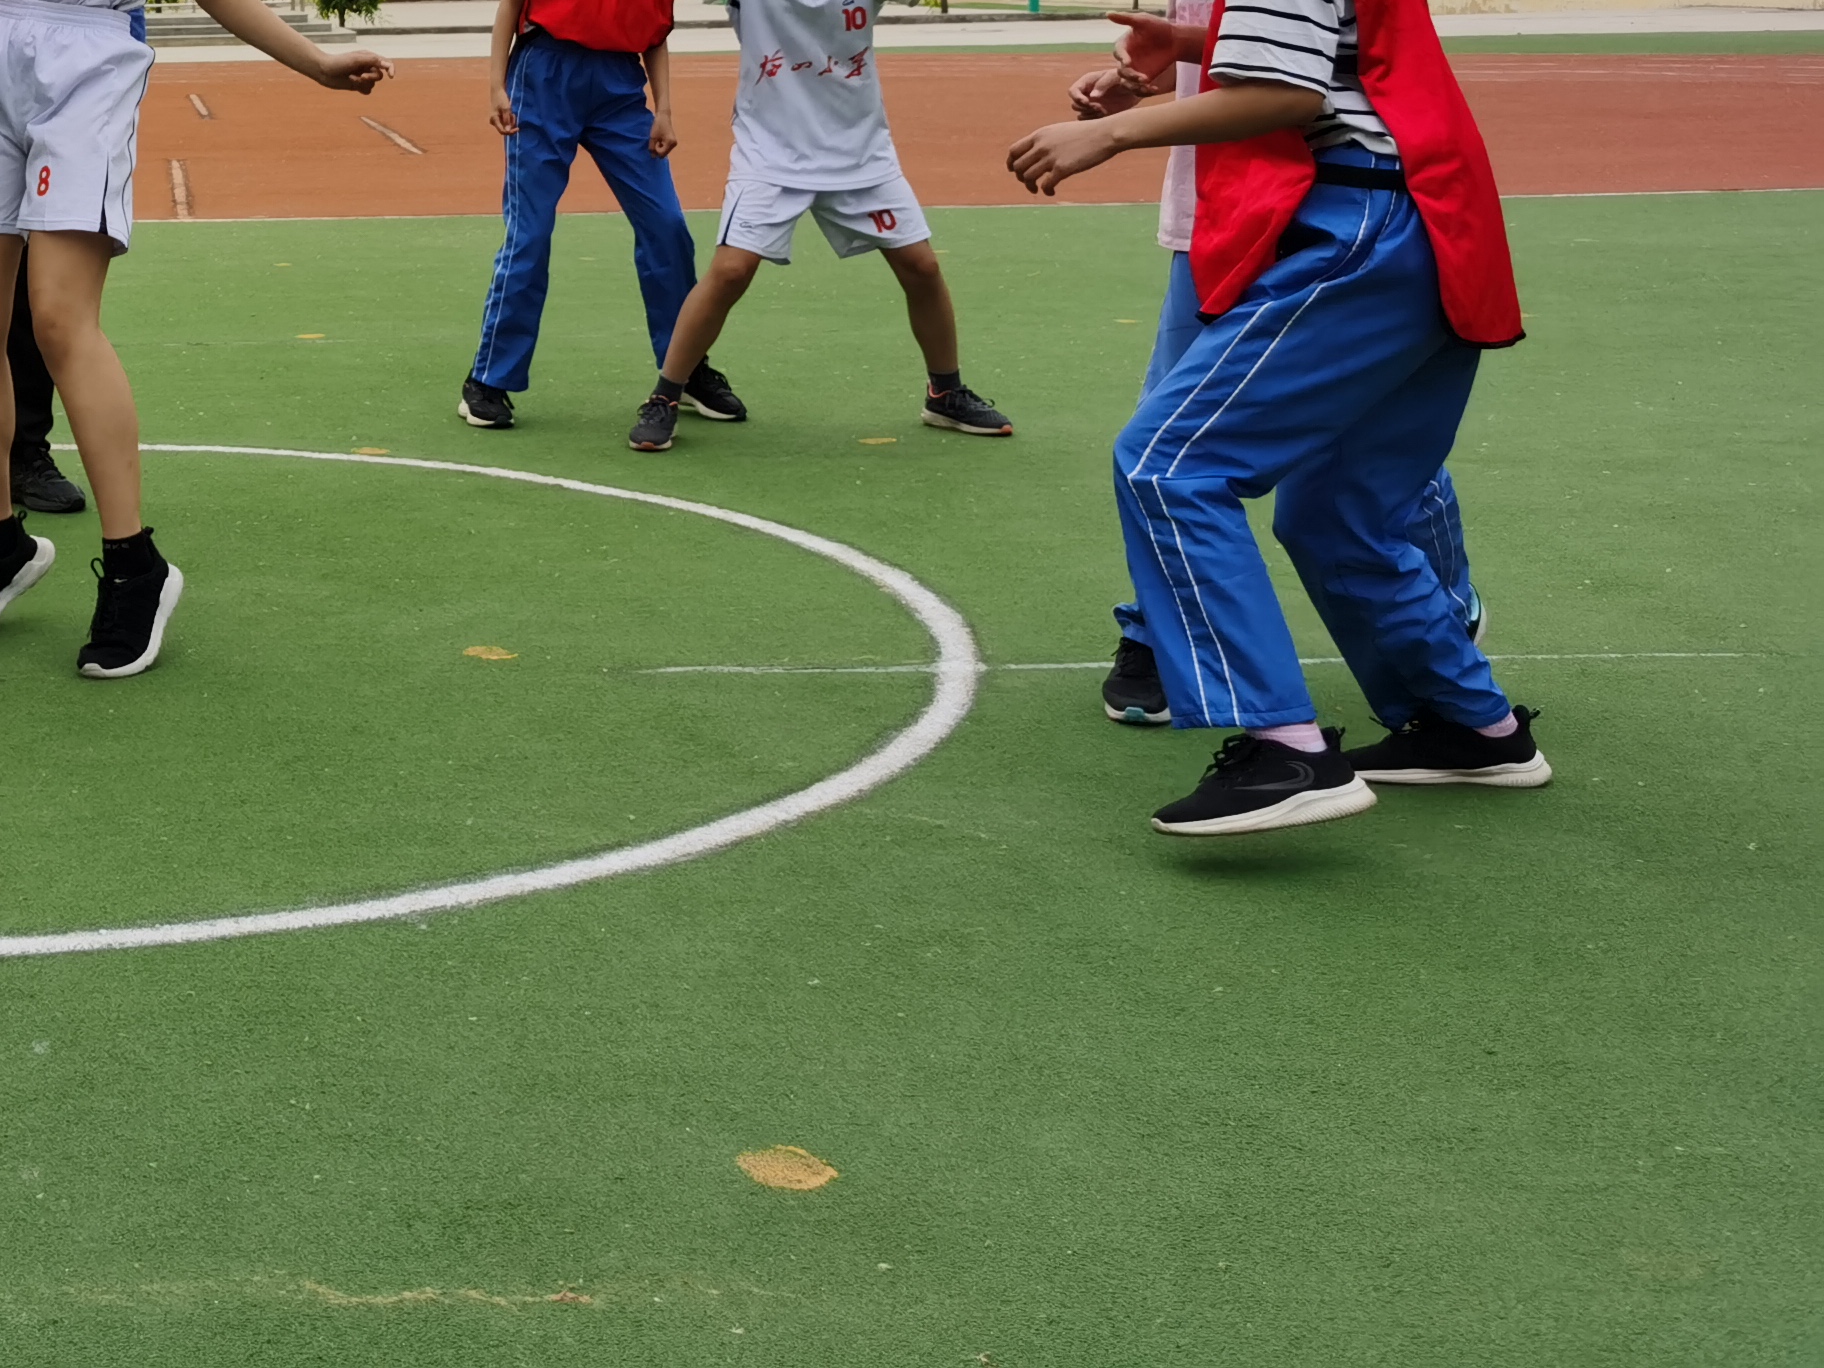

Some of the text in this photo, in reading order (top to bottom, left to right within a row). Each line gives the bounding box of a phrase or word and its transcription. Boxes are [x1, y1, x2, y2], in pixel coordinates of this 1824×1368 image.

[842, 6, 868, 32] 10
[37, 165, 51, 197] 8
[868, 209, 897, 233] 10
